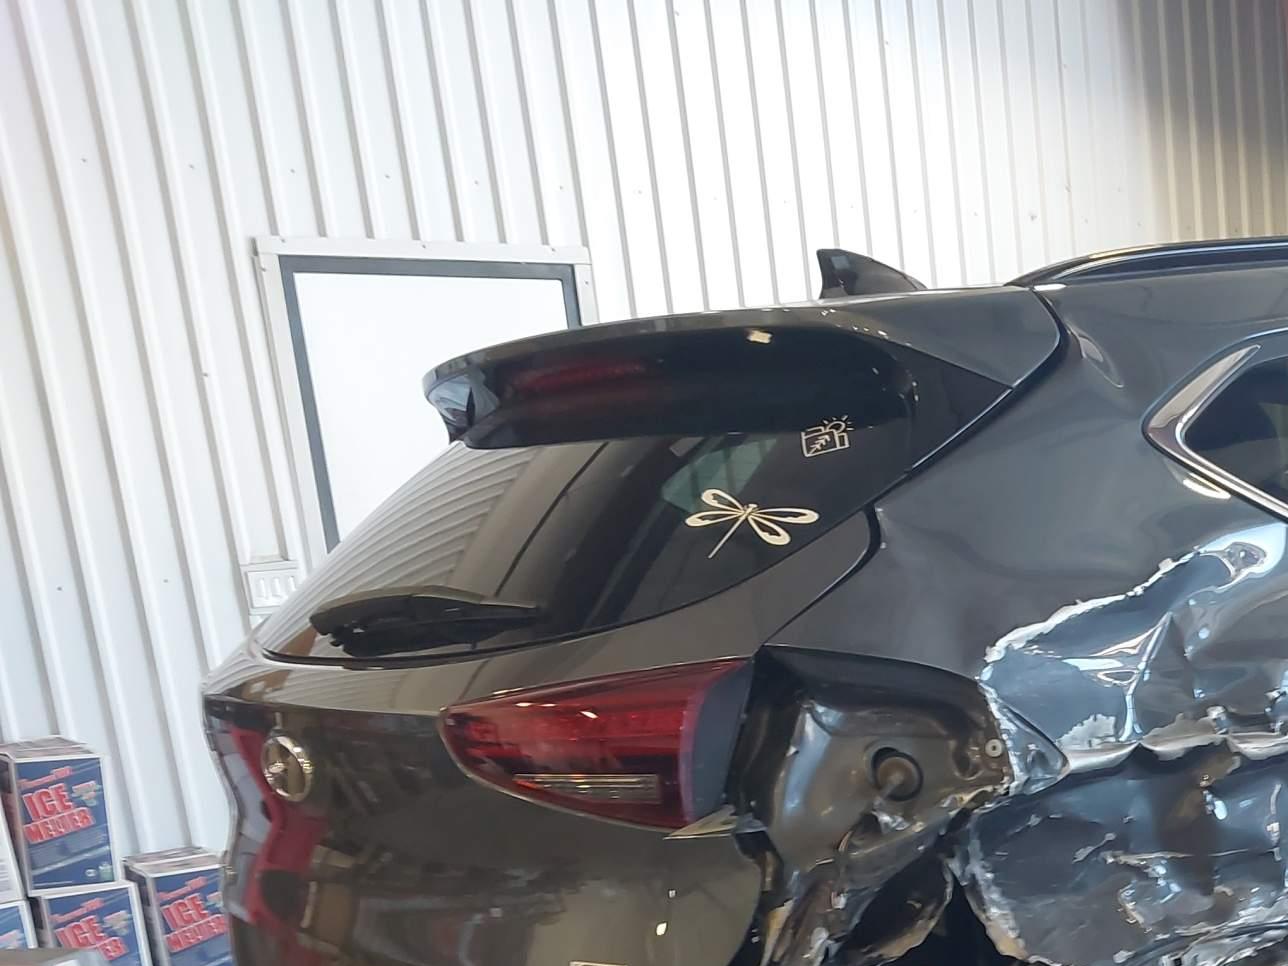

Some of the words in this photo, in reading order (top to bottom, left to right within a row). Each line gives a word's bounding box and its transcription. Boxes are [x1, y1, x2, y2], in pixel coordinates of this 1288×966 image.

[22, 782, 76, 821] ICE
[23, 806, 96, 844] MELTER
[160, 892, 210, 931] ICE
[54, 915, 109, 950] ICE
